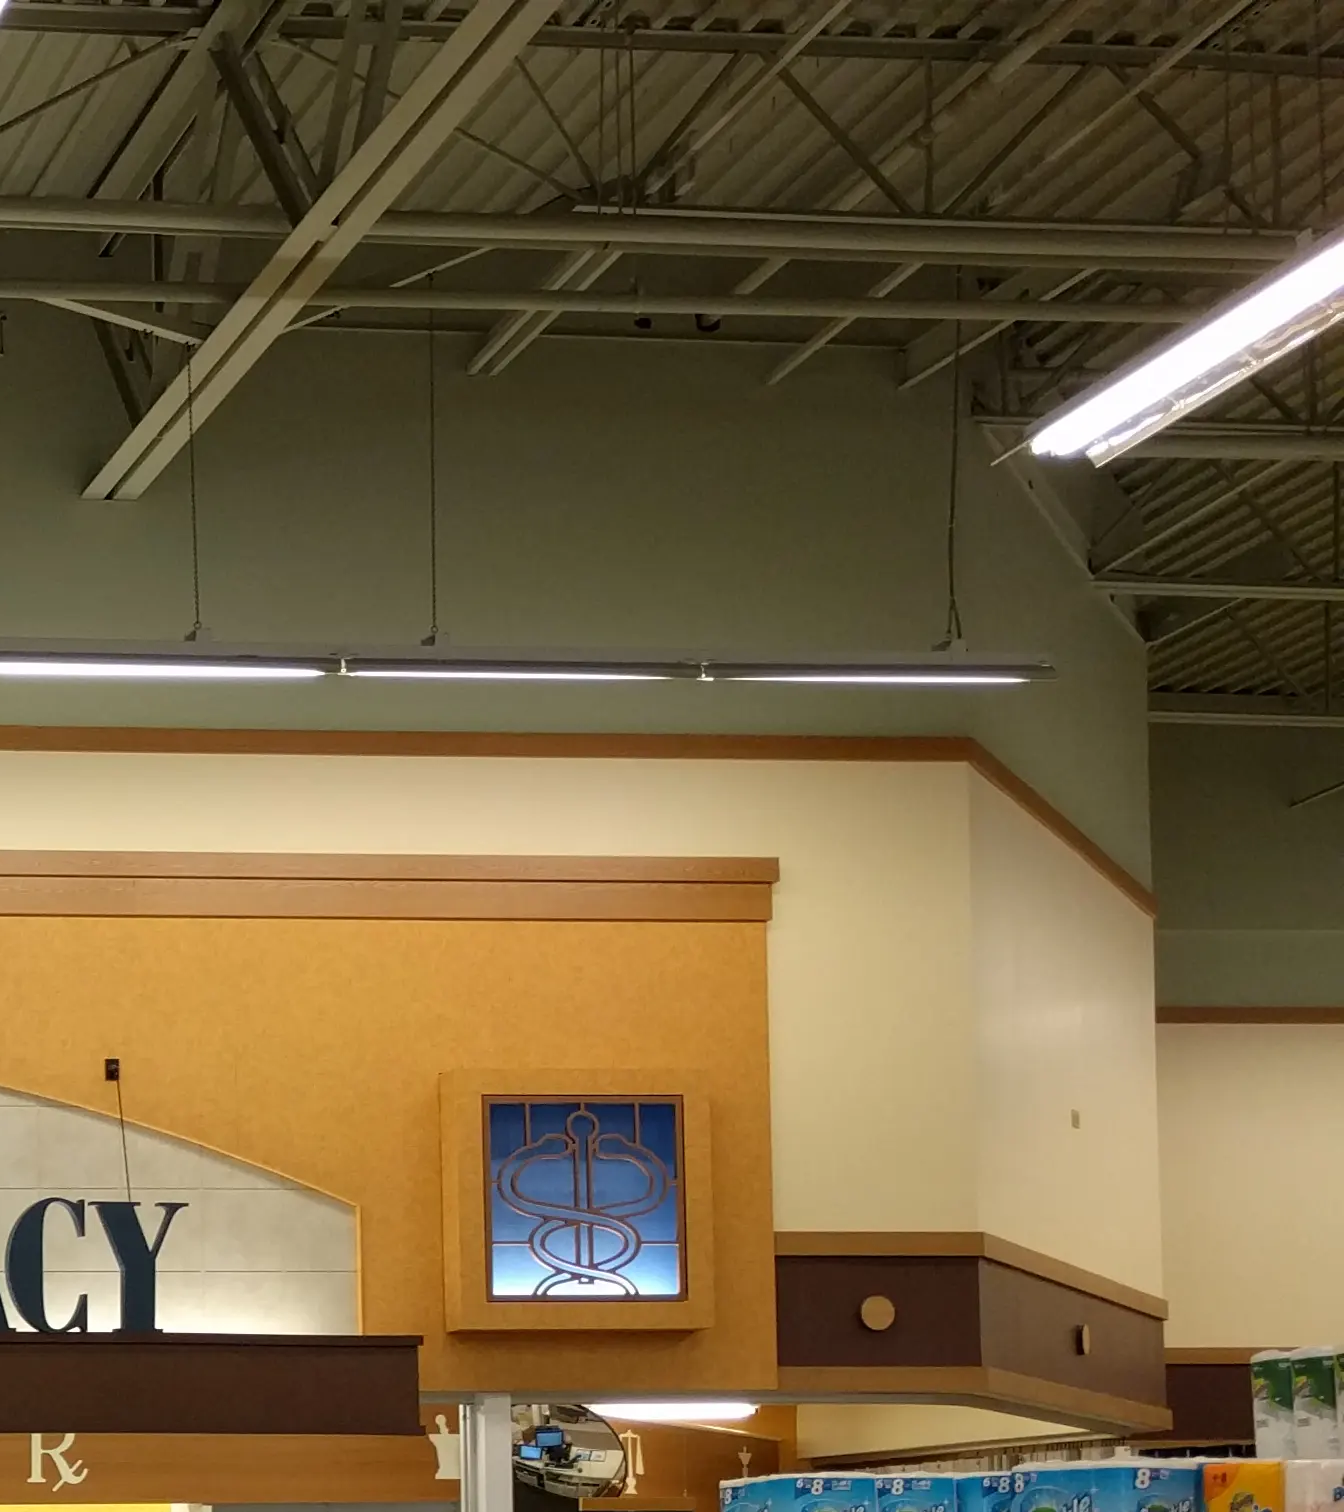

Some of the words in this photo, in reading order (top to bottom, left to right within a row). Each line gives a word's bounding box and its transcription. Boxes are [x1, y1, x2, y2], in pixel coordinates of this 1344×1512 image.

[1135, 1468, 1150, 1489] 8
[812, 1479, 824, 1495] 8
[891, 1479, 904, 1495] 8
